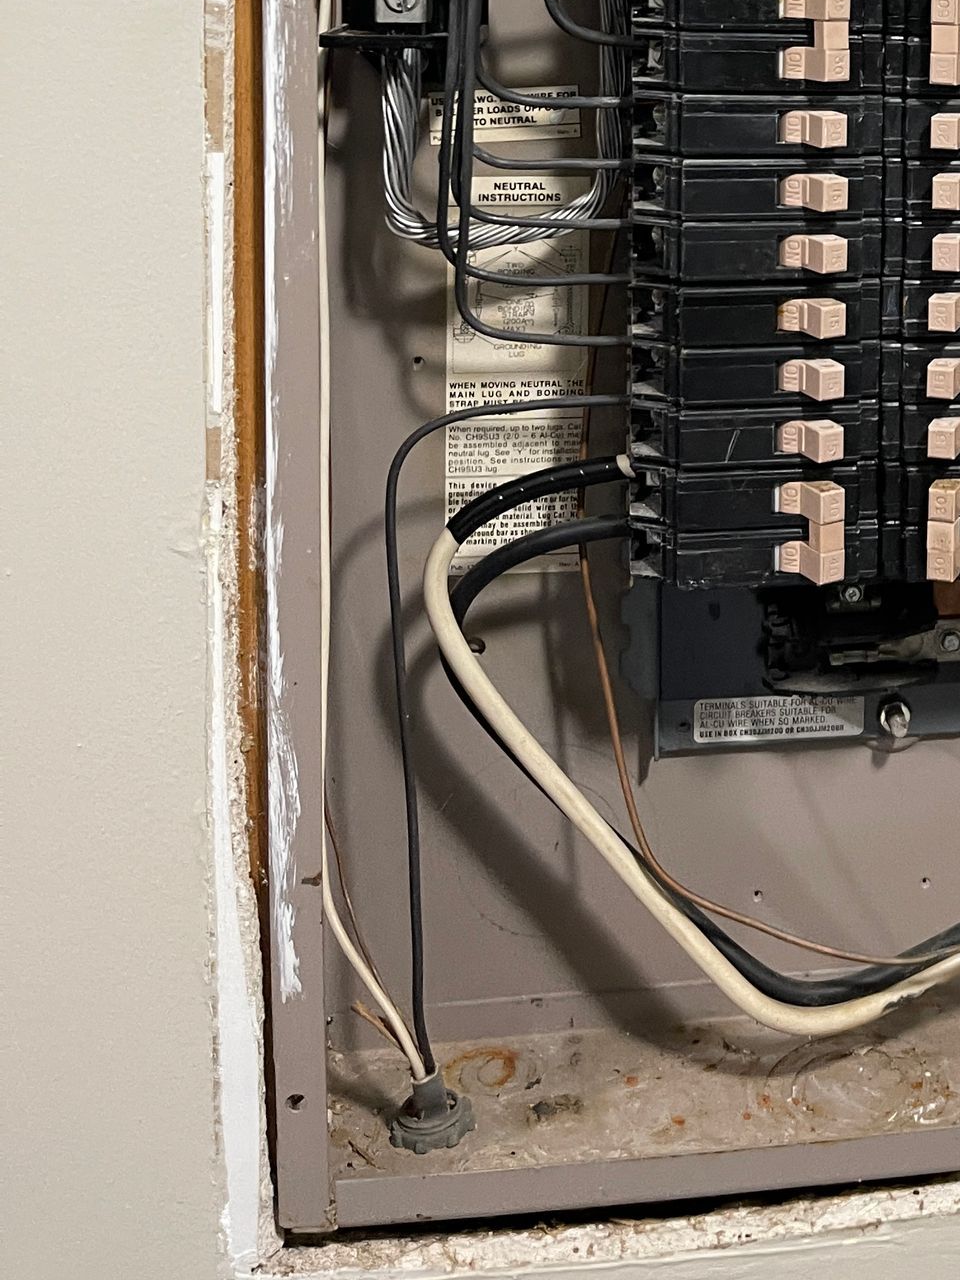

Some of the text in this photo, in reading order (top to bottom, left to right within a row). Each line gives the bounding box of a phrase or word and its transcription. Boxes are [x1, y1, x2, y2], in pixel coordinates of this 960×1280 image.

[487, 106, 521, 115] LOADS
[474, 116, 537, 126] TO NEUTRAL
[494, 182, 546, 191] NEUTRAL
[478, 193, 561, 202] INSTRUCTIONS
[494, 343, 542, 351] GROUNDING
[481, 381, 516, 389] MOVING
[521, 380, 562, 388] NEUTRAL
[482, 390, 503, 398] LUG
[537, 389, 584, 397] BONDING
[449, 400, 479, 408] STRAP
[510, 426, 520, 434] up
[463, 441, 508, 449] assembled
[512, 440, 547, 450] adjacent
[449, 450, 476, 458] neutral
[490, 457, 507, 465] See
[511, 456, 562, 464] instructions
[449, 482, 466, 490] This
[448, 498, 459, 506] ble
[502, 512, 534, 520] material.
[537, 511, 551, 521] Lug
[481, 520, 552, 532] may be assembled
[496, 528, 509, 536] bar
[466, 537, 497, 546] marking
[700, 701, 746, 711] TERMINALS
[750, 699, 787, 709] SUITABLE
[791, 698, 807, 707] FOR
[700, 706, 836, 720] CIRCUIT BREAKERS SUITABLE FOR
[700, 720, 725, 729] AL-CU
[728, 719, 748, 728] WIRE
[751, 718, 775, 726] WHEN
[778, 717, 789, 725] SO
[700, 730, 713, 738] USE
[724, 729, 737, 737] BOX
